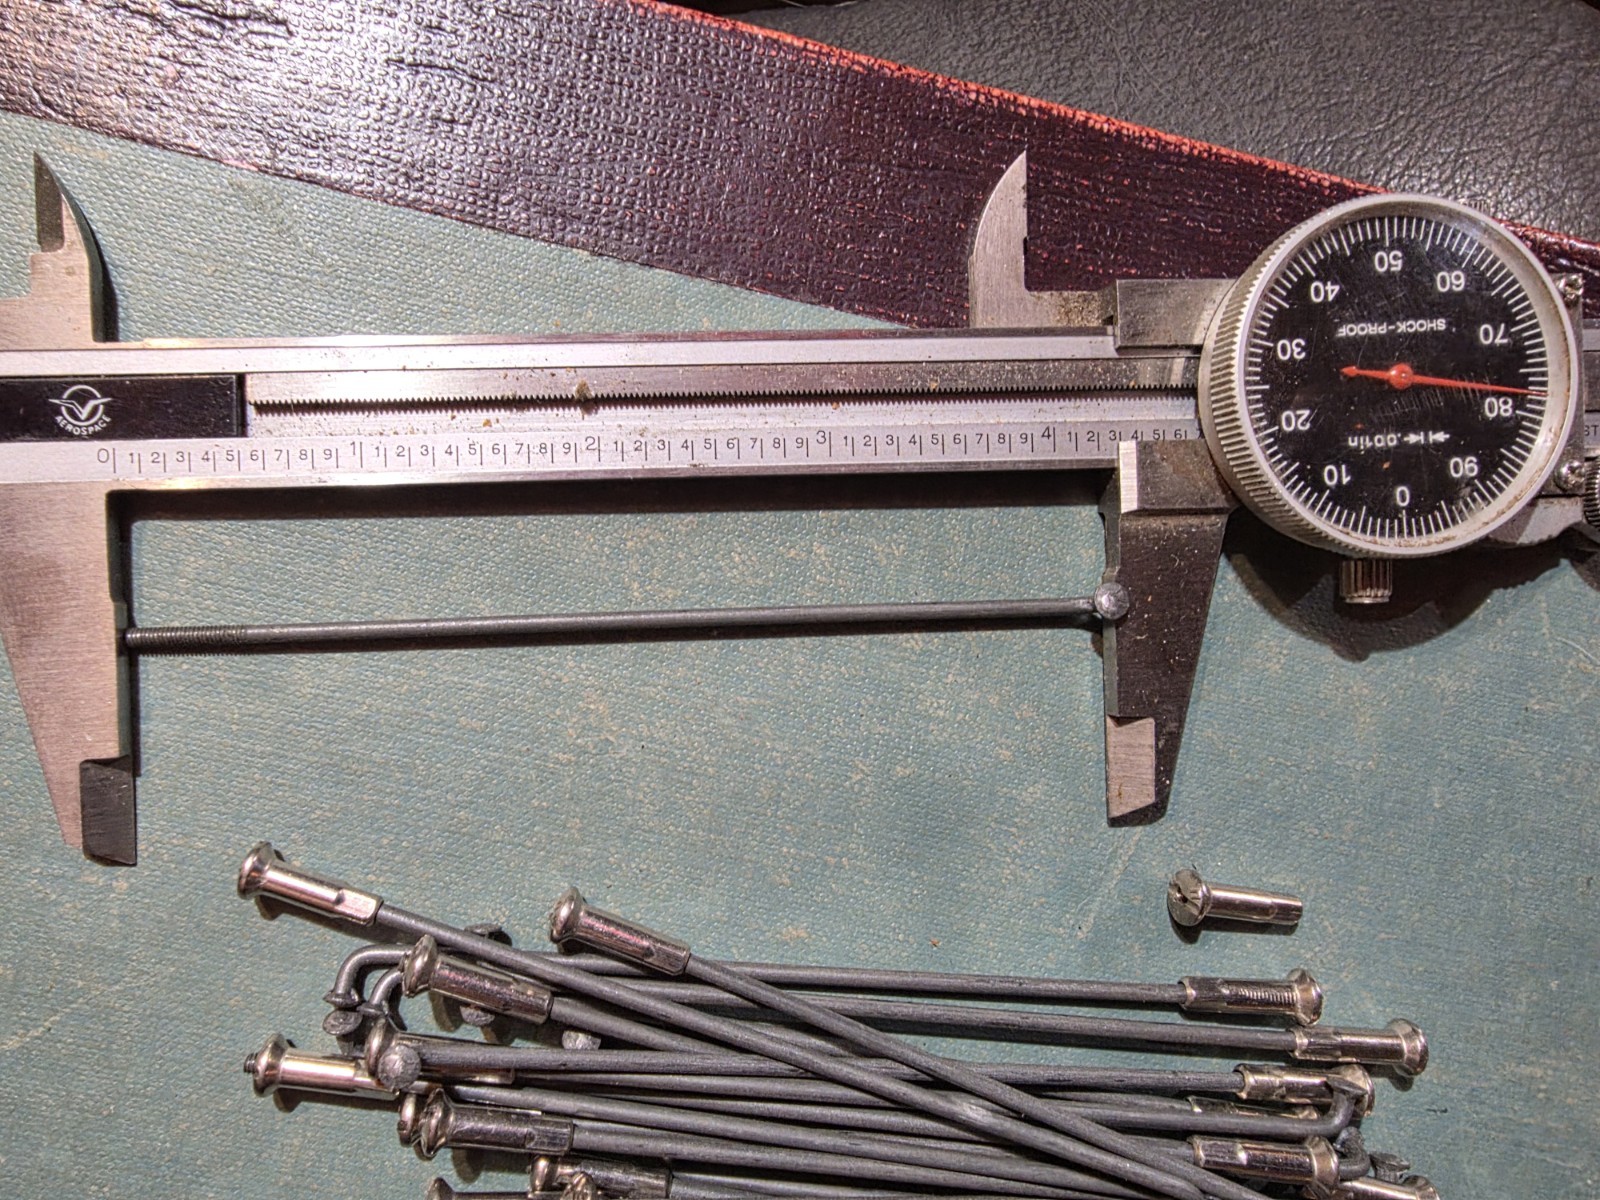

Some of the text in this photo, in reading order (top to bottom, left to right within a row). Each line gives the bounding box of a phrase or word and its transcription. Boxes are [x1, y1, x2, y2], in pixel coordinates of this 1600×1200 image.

[1374, 250, 1403, 273] 50
[1310, 280, 1341, 304] 40
[1436, 270, 1466, 293] 60
[1337, 318, 1446, 337] SHOCK-PROOF
[1479, 322, 1509, 345] 70
[1276, 338, 1306, 361] 30
[1484, 396, 1513, 419] 80
[55, 414, 112, 435] AEROSPACE
[1281, 408, 1311, 432] 20
[97, 448, 110, 464] 0
[129, 452, 135, 464] 1
[150, 452, 161, 464] 2
[175, 451, 186, 463] 3
[201, 451, 211, 463] 4
[226, 450, 235, 462] 5
[249, 449, 259, 461] 6
[273, 449, 284, 461] 7
[298, 448, 308, 461] 8
[323, 448, 333, 460] 9
[350, 441, 356, 456] 1
[375, 445, 380, 457] 1
[396, 445, 406, 458] 2
[419, 445, 429, 457] 3
[444, 444, 453, 456] 4
[468, 443, 477, 455] 5
[491, 443, 501, 455] 6
[514, 443, 524, 455] 7
[538, 442, 548, 455] 8
[562, 442, 572, 455] 9
[584, 436, 597, 451] 2
[613, 441, 619, 452] 1
[633, 440, 643, 452] 2
[657, 439, 666, 451] 3
[681, 438, 690, 451] 4
[703, 438, 713, 450] 5
[726, 438, 736, 450] 6
[749, 437, 759, 449] 7
[772, 437, 782, 449] 8
[795, 437, 804, 449] 9
[815, 430, 827, 444] 3
[843, 435, 848, 447] 1
[863, 435, 873, 447] 2
[885, 434, 895, 446] 3
[908, 433, 918, 446] 4
[931, 433, 940, 445] 5
[952, 433, 962, 445] 6
[974, 433, 984, 445] 7
[997, 433, 1006, 445] 8
[1019, 432, 1028, 444] 9
[1040, 425, 1052, 440] 4
[1067, 431, 1073, 443] 1
[1086, 430, 1096, 443] 2
[1108, 429, 1117, 441] 3
[1130, 428, 1140, 440] 4
[1152, 428, 1161, 441] 5
[1174, 428, 1183, 440] 6
[1323, 463, 1352, 487] 10
[1450, 456, 1479, 479] 90
[1395, 486, 1411, 507] 0
